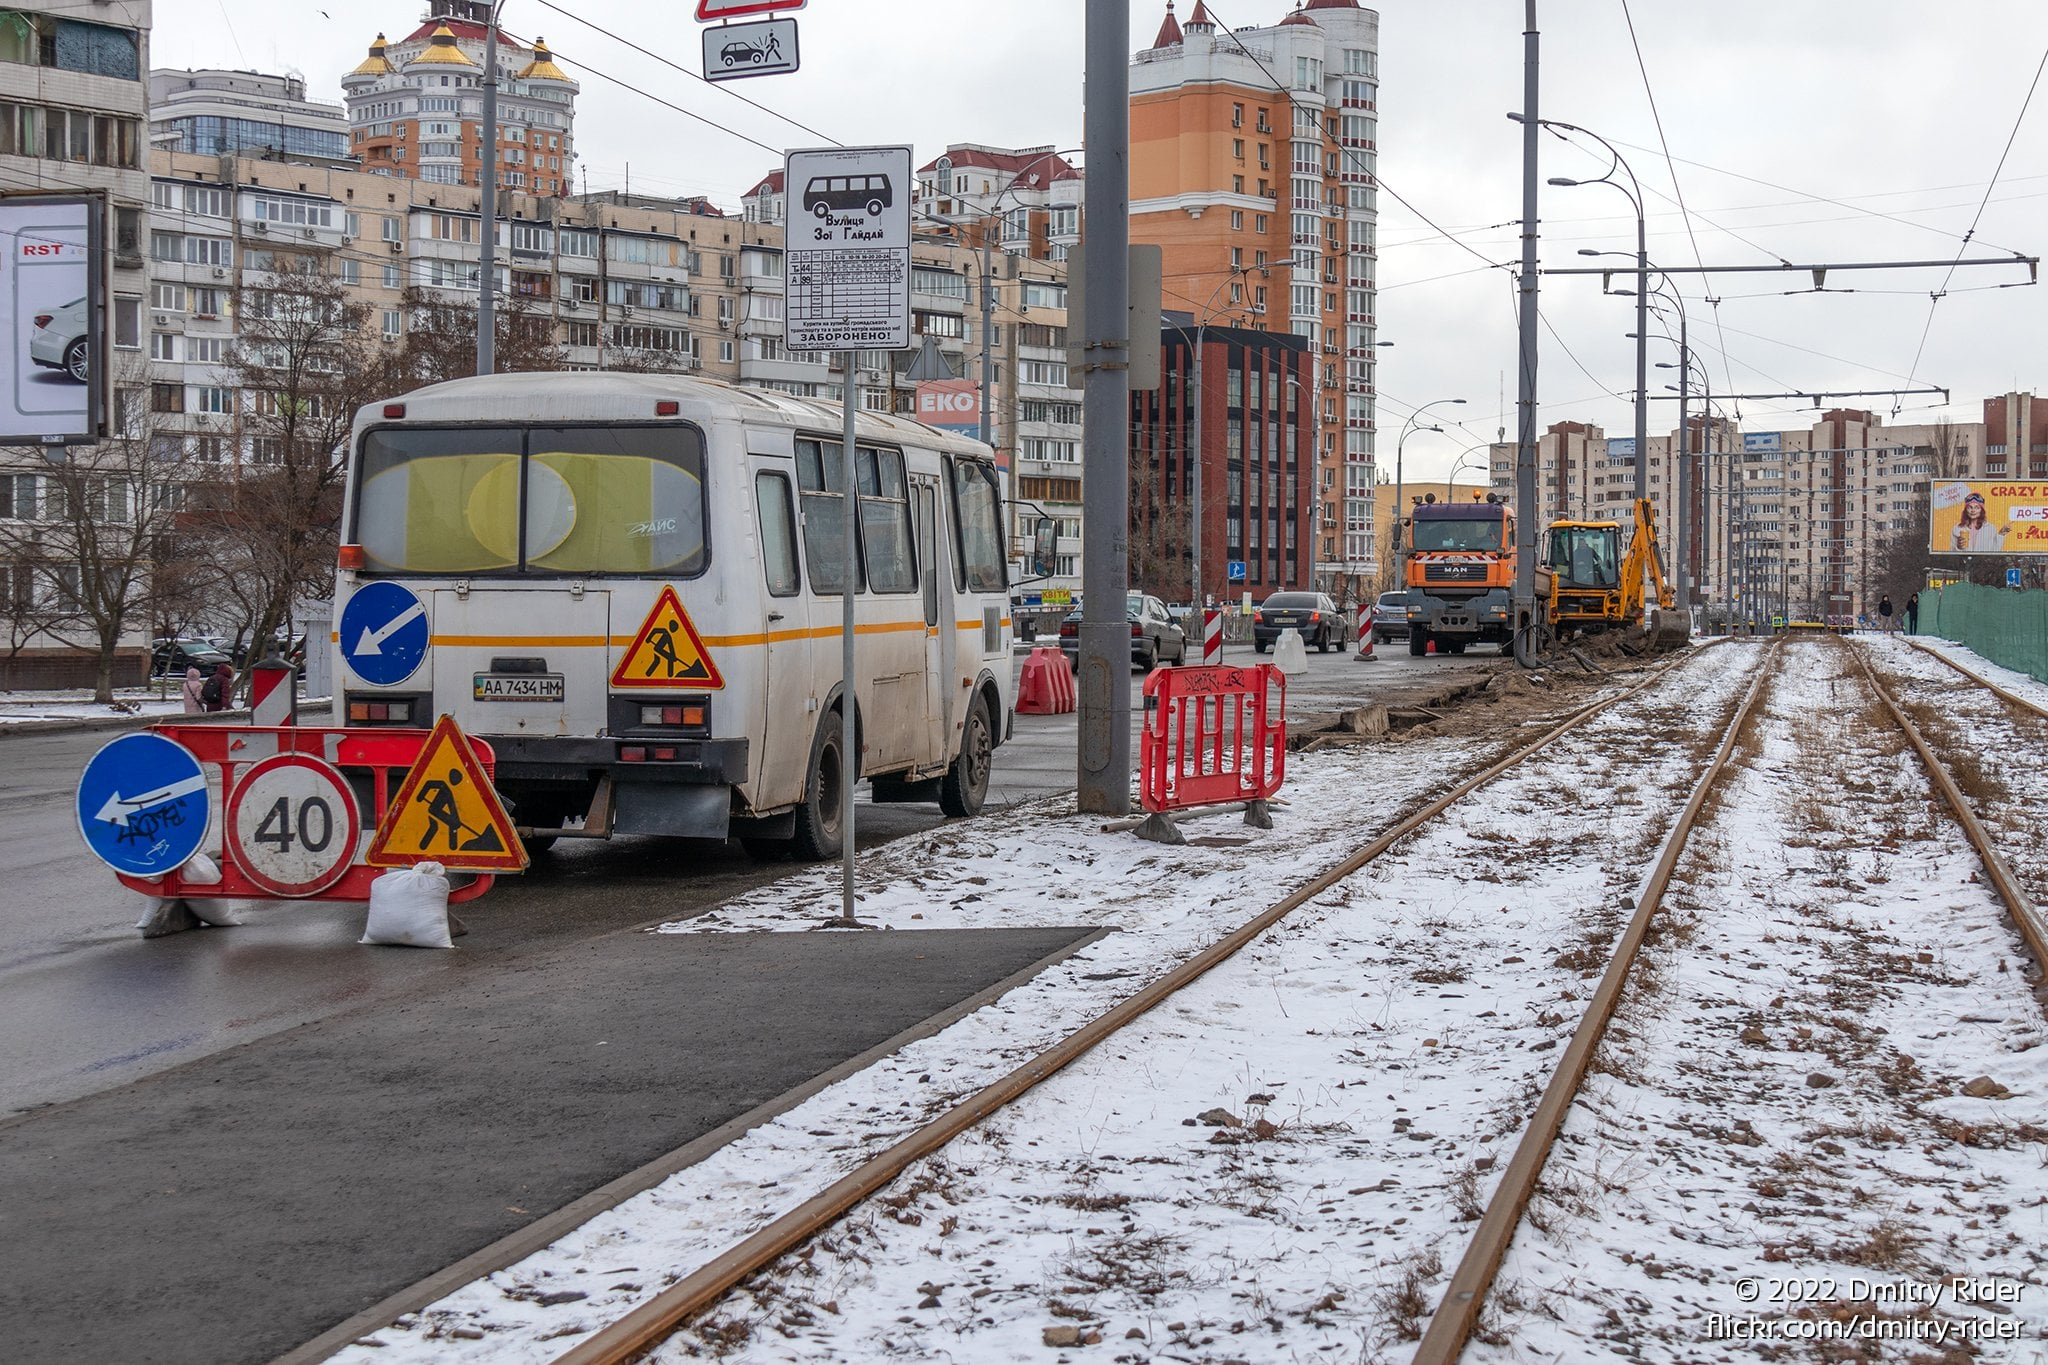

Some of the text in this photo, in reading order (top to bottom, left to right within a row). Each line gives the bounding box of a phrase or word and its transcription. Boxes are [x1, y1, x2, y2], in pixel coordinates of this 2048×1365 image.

[825, 214, 864, 227] Вулиця
[814, 227, 883, 240] Зої Гайдай
[23, 244, 64, 256] RST
[800, 332, 891, 342] ЗАБОРОНЕНО!
[1990, 486, 2037, 497] CRAZY
[1042, 590, 1070, 599] КВІТИ
[484, 680, 560, 695] AA 7434 HM
[254, 796, 333, 853] 40
